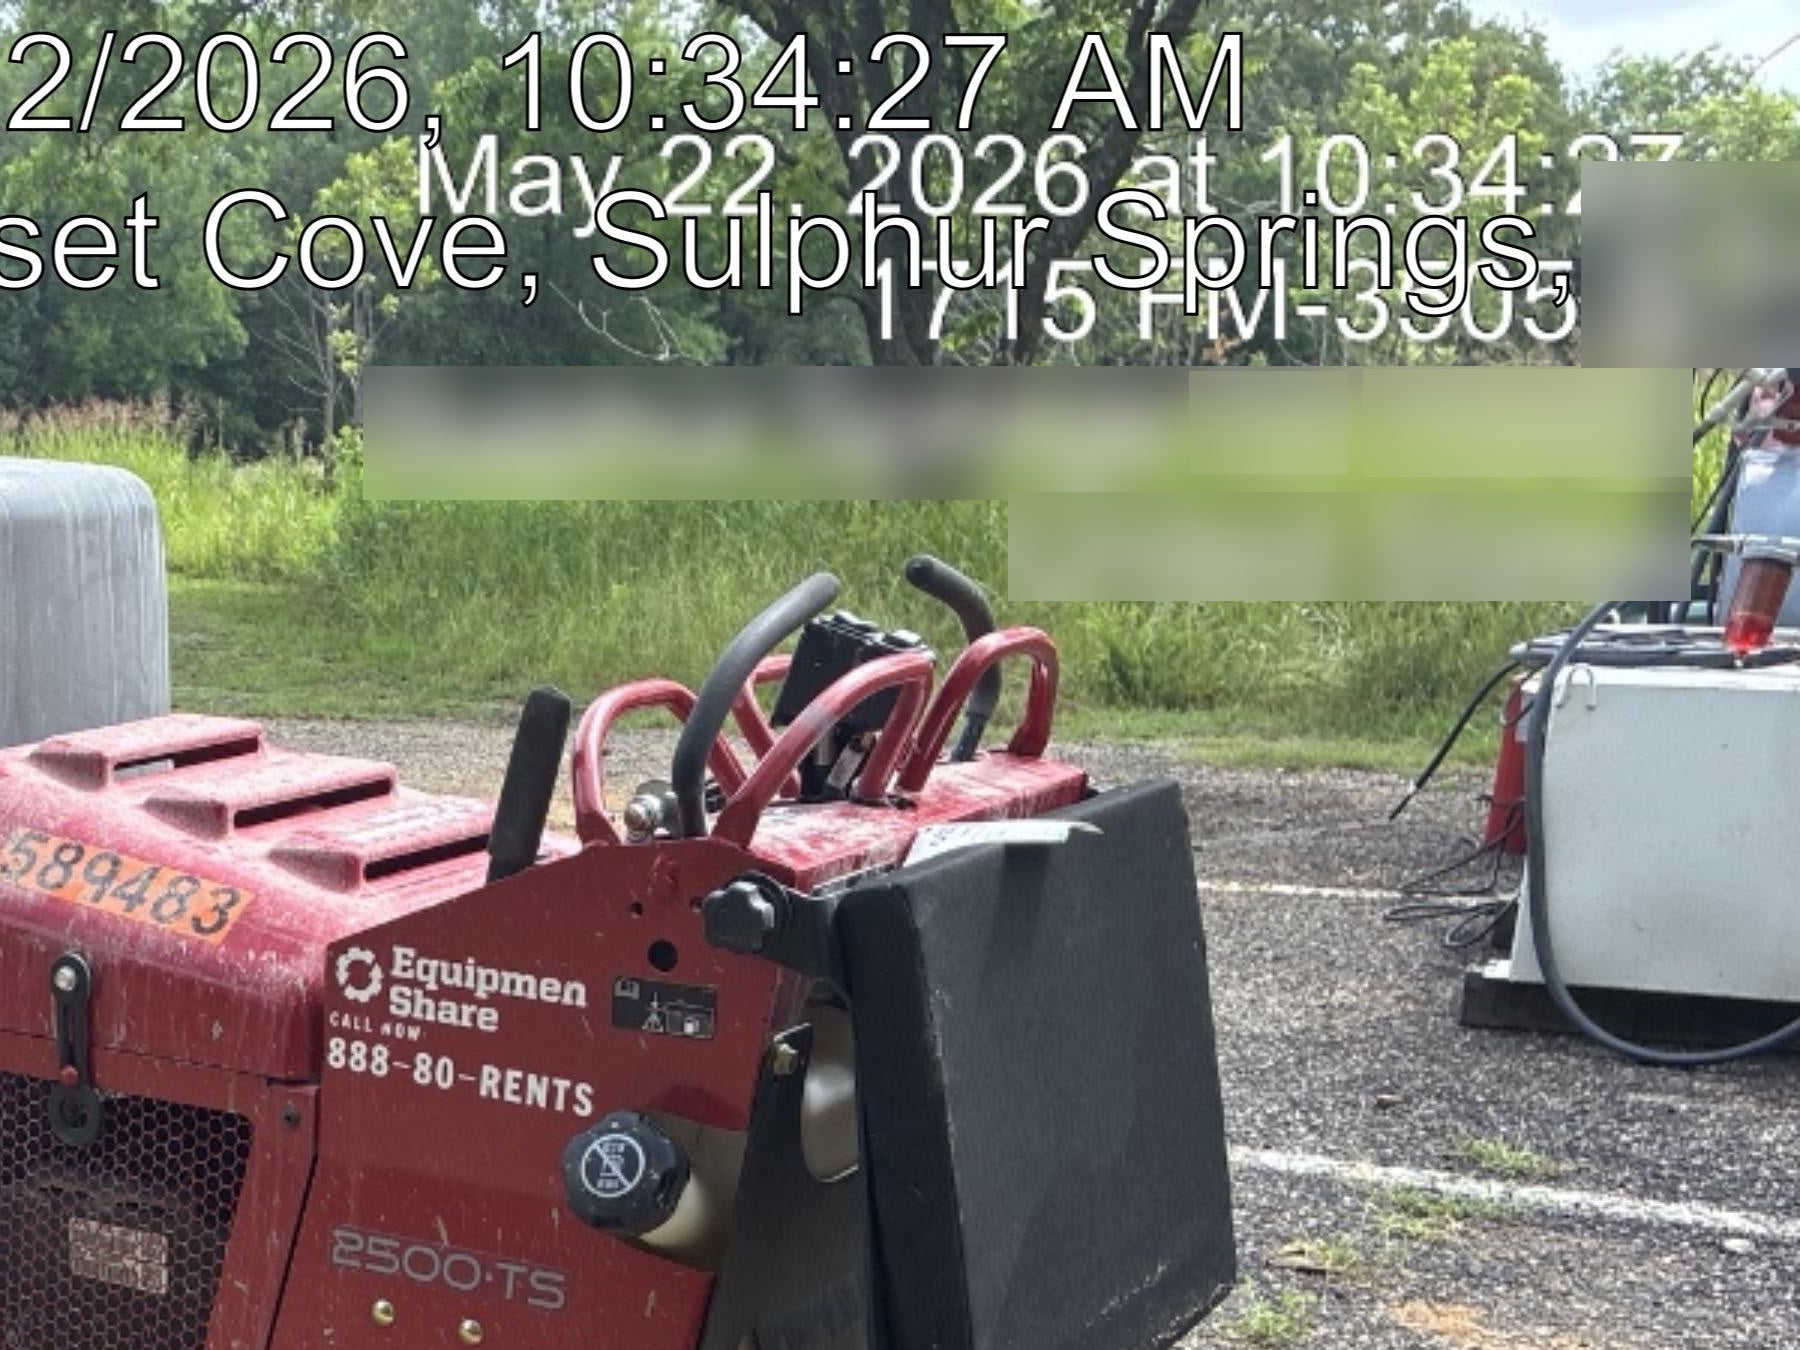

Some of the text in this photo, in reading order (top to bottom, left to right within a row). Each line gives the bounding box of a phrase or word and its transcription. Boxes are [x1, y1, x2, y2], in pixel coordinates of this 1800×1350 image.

[390, 945, 589, 1009] Equipmen
[329, 1010, 422, 1042] CALL NOW
[388, 985, 500, 1033] Share
[327, 1036, 595, 1118] 888-80-RENTS
